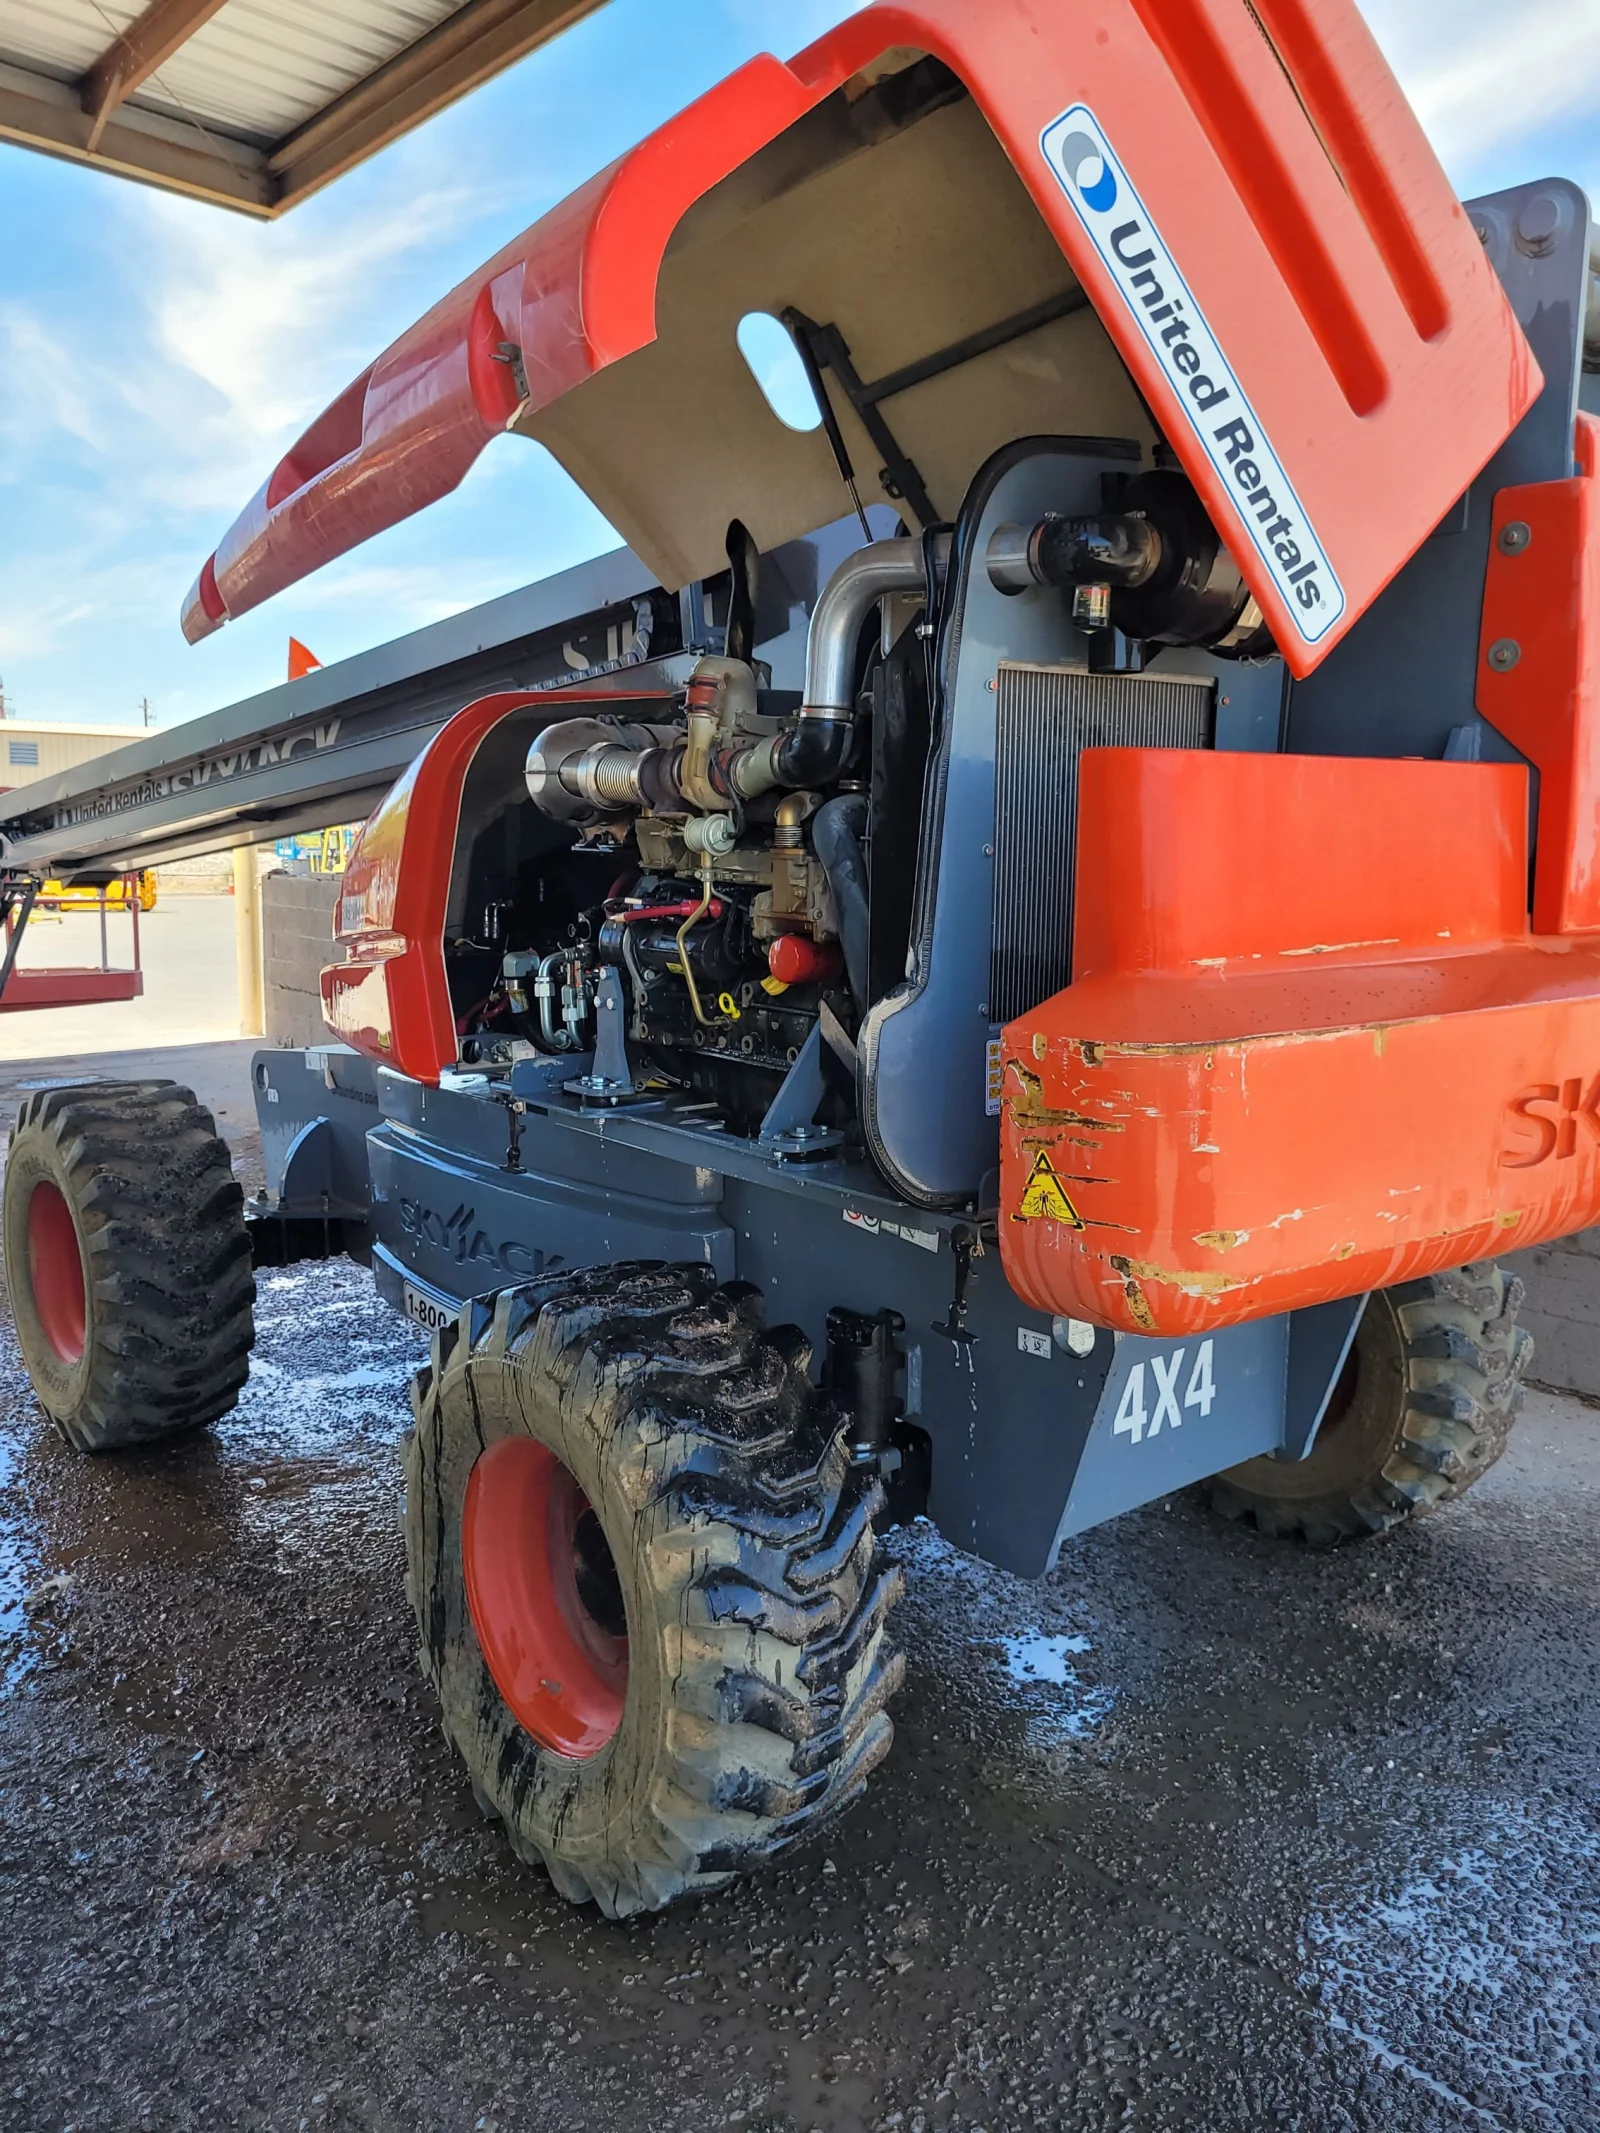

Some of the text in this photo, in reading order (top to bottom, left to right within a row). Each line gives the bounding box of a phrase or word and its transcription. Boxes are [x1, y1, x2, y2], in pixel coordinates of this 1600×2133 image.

[1110, 220, 1321, 610] United Rentals
[400, 1197, 565, 1280] SKYJACK
[1113, 1338, 1217, 1445] 4X4
